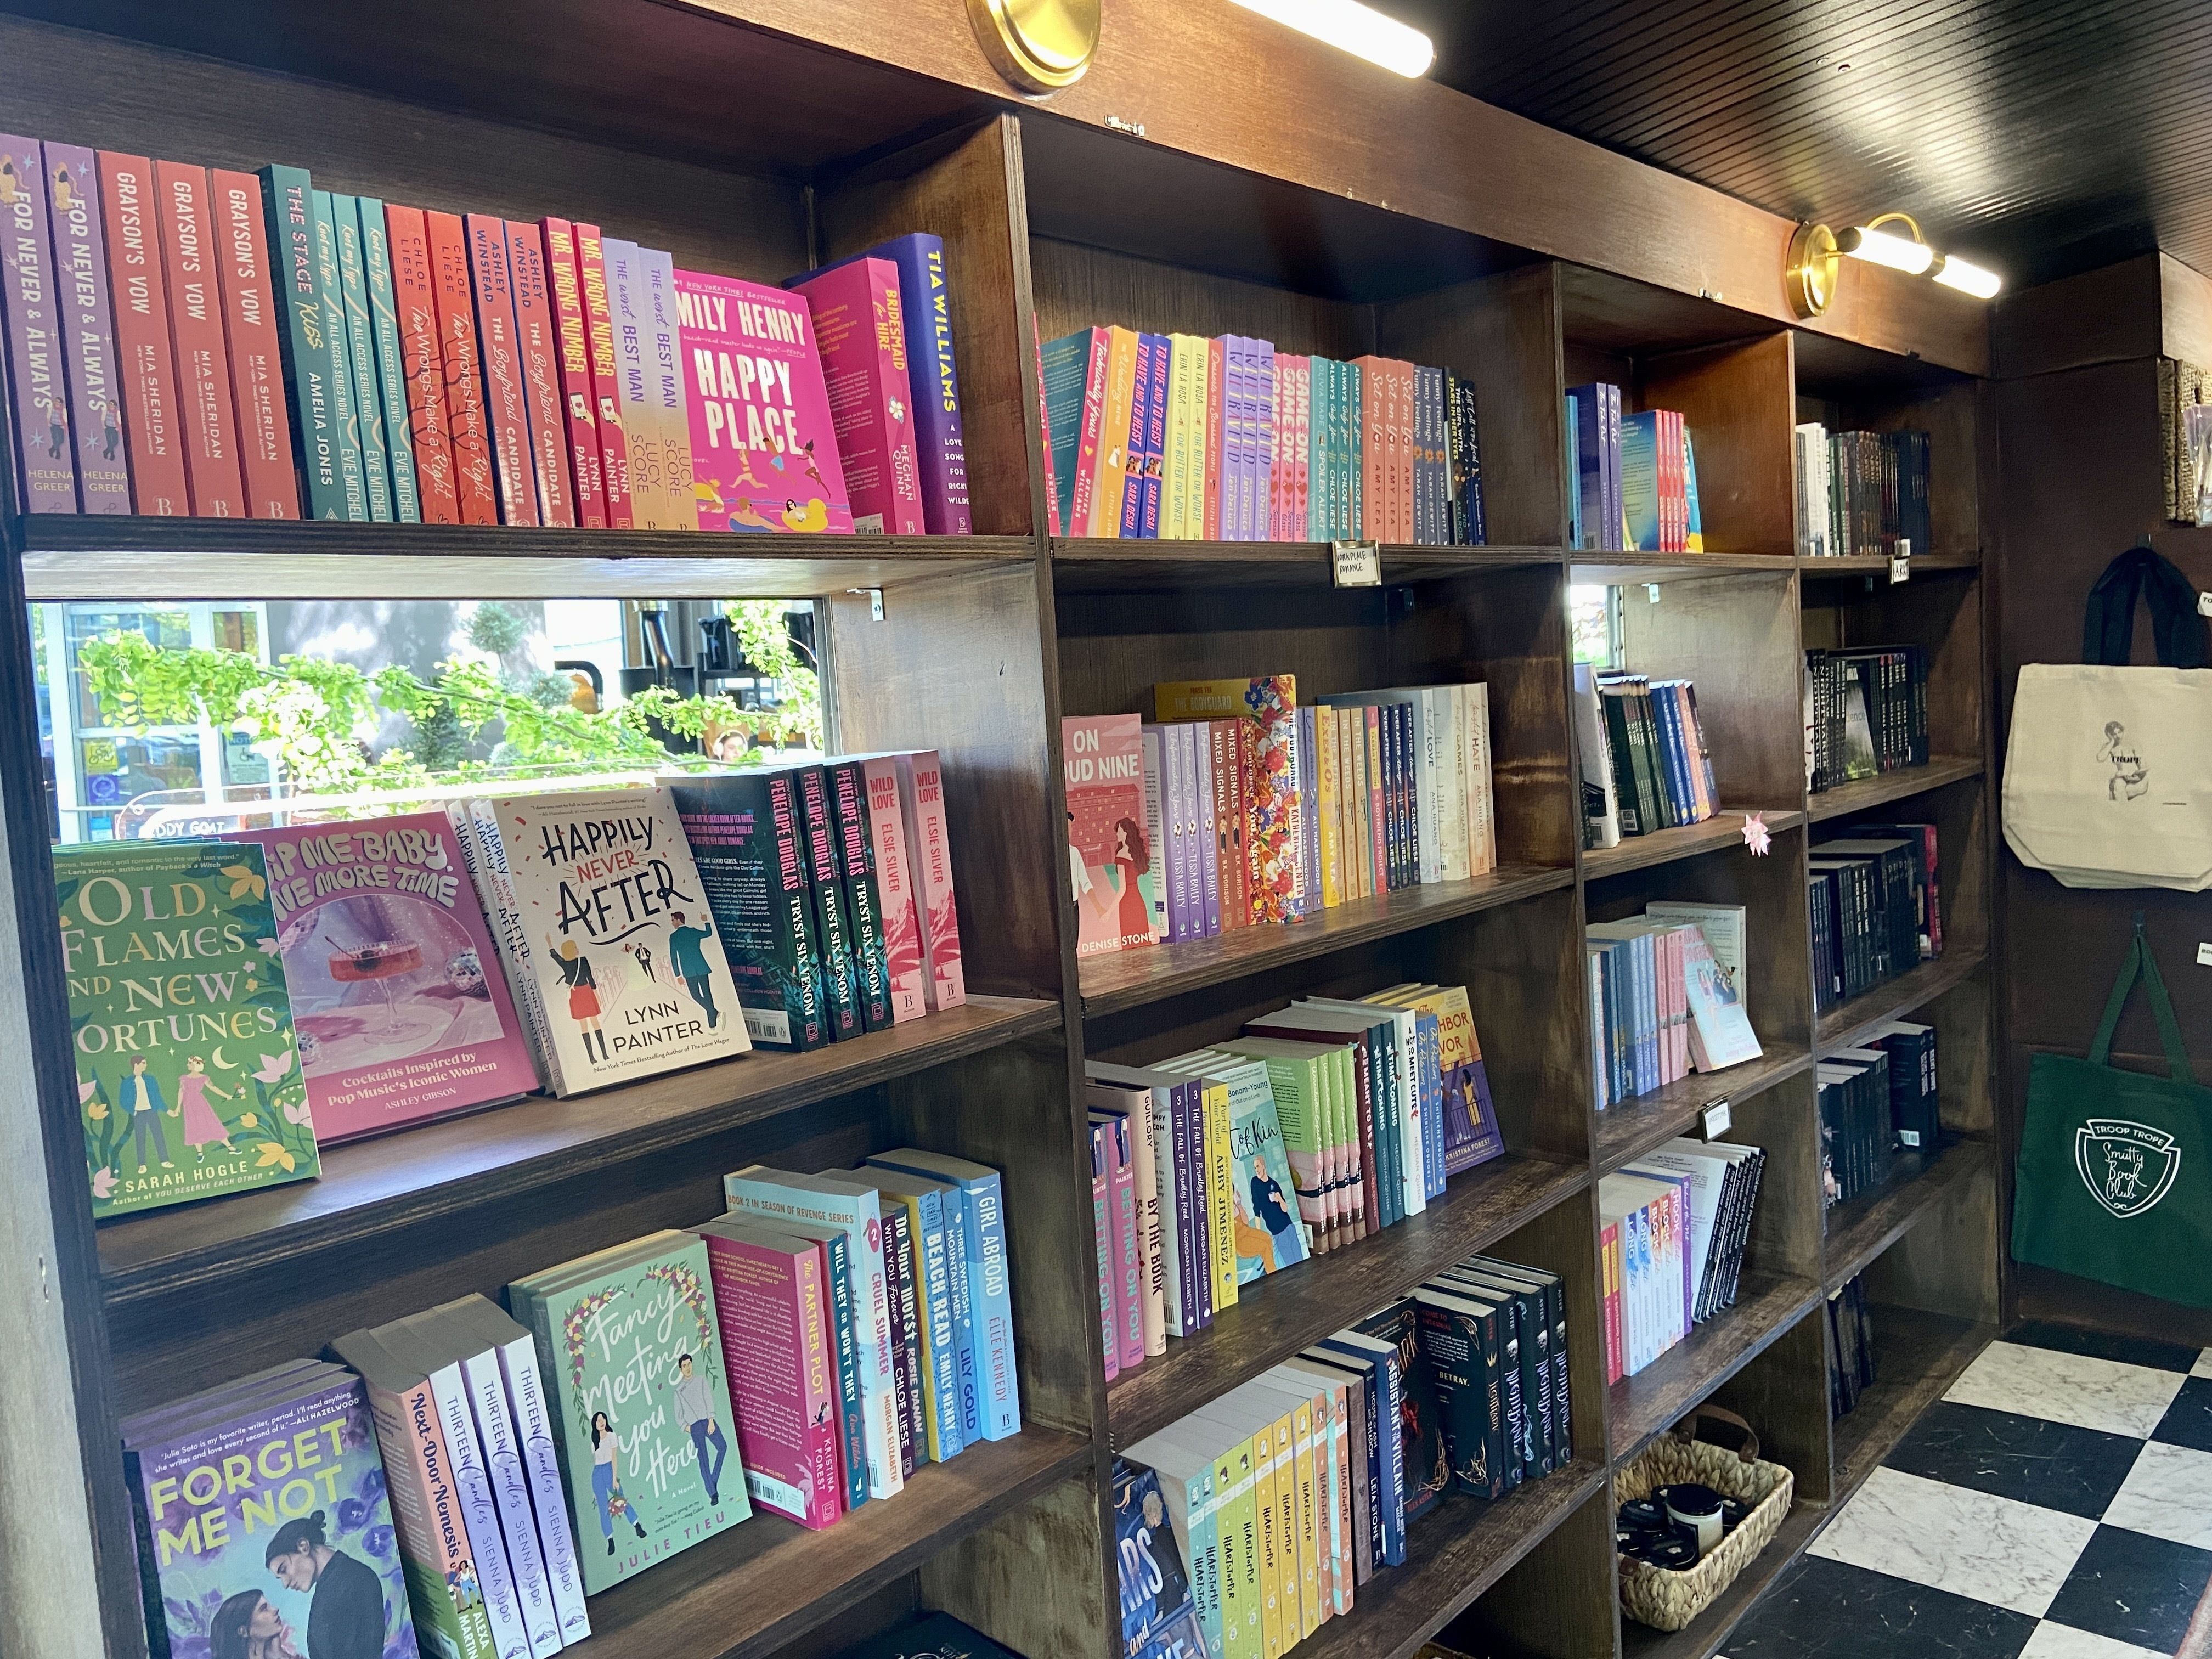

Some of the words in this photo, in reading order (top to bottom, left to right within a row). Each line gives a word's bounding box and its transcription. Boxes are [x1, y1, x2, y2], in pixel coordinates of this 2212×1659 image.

[12, 190, 34, 231] FOR
[287, 185, 305, 225] THE
[229, 189, 256, 278] GRAYSON'S
[549, 231, 573, 256] MR.
[16, 235, 41, 302] NEVER
[292, 231, 312, 294] STAGE
[616, 259, 628, 280] THE
[928, 251, 943, 289] TIA
[552, 263, 580, 311] WRONG
[619, 285, 636, 319] worst
[724, 287, 743, 296] TIMES
[747, 292, 786, 305] BESTSELLER
[27, 308, 37, 319] &
[240, 289, 261, 325] VOW
[295, 301, 323, 350] Kiss
[675, 290, 727, 332] MILY
[737, 301, 805, 346] HENRY
[560, 316, 587, 373] NUMBER
[623, 325, 641, 364] BEST
[877, 321, 890, 351] HIRE
[885, 289, 905, 371] BRIDESMAID
[26, 325, 52, 410] ALWAYS
[256, 356, 267, 380] MIA
[933, 294, 956, 412] WILLIAMS
[1156, 345, 1167, 359] TO
[628, 369, 644, 402] MAN
[693, 348, 793, 407] HAPPY
[1154, 360, 1166, 388] HAVE
[309, 372, 326, 430] AMELIA
[1152, 407, 1163, 418] TO
[1153, 390, 1164, 405] AND
[259, 386, 278, 460] SHERIDAN
[704, 400, 804, 455] PLACE
[1150, 420, 1163, 449] HEIST
[317, 435, 332, 486] JONES
[944, 438, 962, 447] LOVE
[945, 453, 964, 461] SONG
[28, 469, 74, 481] HELENA
[631, 435, 649, 493] SCORE
[646, 443, 661, 488] LUCY
[33, 482, 71, 492] GREER
[948, 482, 967, 490] RICKI
[1147, 484, 1157, 504] SARA
[1146, 506, 1156, 531] DESAI
[1340, 562, 1364, 574] ROMANCE
[1073, 729, 1098, 753] ON
[1214, 732, 1223, 764] MIXED
[870, 777, 894, 793] WILD
[1098, 754, 1139, 778] NINE
[770, 778, 785, 836] PENELOPE
[873, 794, 895, 810] LOVE
[1216, 766, 1226, 813] SIGNALS
[542, 816, 653, 866] HAPPILY
[882, 823, 896, 855] ELSIE
[576, 849, 639, 884] NEVER
[777, 836, 798, 891] DOUGLAS
[885, 858, 900, 893] SILVER
[78, 876, 206, 926] OLD
[272, 882, 315, 923] NE
[316, 865, 390, 898] MORE
[558, 859, 694, 937] AFTER
[791, 896, 804, 937] TRYST
[62, 924, 245, 972] FLAMES
[796, 939, 808, 964] SIX
[1081, 938, 1119, 952] DENISE
[1121, 932, 1155, 945] STONE
[69, 976, 110, 998] ND
[119, 970, 239, 1013] NEW
[799, 966, 814, 1016] VENOM
[77, 1006, 277, 1054] ORTUNES
[625, 1000, 679, 1025] LYNN
[613, 1020, 703, 1053] PAINTER
[1406, 1036, 1415, 1046] NOT
[342, 1066, 403, 1088] Cocktails
[405, 1054, 459, 1075] Inspired
[464, 1051, 478, 1064] by
[637, 1053, 665, 1063] Bestselling
[328, 1092, 354, 1107] Pop
[357, 1082, 408, 1102] Music's
[409, 1071, 445, 1090] Iconic
[449, 1060, 498, 1082] Women
[385, 1096, 420, 1110] ASHLEY
[422, 1087, 456, 1103] GIBSON
[1228, 1081, 1268, 1098] Bonam-Young
[2103, 1142, 2143, 1168] Smutty
[2134, 1129, 2165, 1146] TROPE
[126, 1172, 184, 1193] SARAH
[193, 1161, 248, 1181] HOGLE
[1216, 1155, 1225, 1191] ABBY
[2106, 1180, 2137, 1199] Club
[2107, 1160, 2147, 1187] Book
[728, 1195, 743, 1205] BOOK
[761, 1201, 785, 1214] SEASON
[787, 1206, 794, 1215] OF
[797, 1207, 826, 1221] REVENGE
[828, 1212, 854, 1224] SERIES
[978, 1197, 998, 1233] GIRL
[1147, 1197, 1159, 1218] BY
[1149, 1221, 1160, 1249] THE
[1217, 1196, 1229, 1265] JIMENEZ
[1651, 1205, 1660, 1249] BLOCK
[925, 1233, 945, 1294] BEACH
[982, 1235, 1003, 1298] ABROAD
[1150, 1250, 1164, 1295] BOOK
[585, 1284, 695, 1363] Fancy
[932, 1297, 951, 1348] READ
[582, 1334, 703, 1424] Meeting
[938, 1352, 952, 1393] EMILY
[960, 1348, 973, 1377] LILY
[1439, 1370, 1470, 1387] BETRAY.
[520, 1365, 542, 1435] THIRTEEN
[940, 1394, 955, 1432] HENRY
[962, 1383, 977, 1431] GOLD
[1388, 1362, 1400, 1430] ASSISTANT
[619, 1404, 667, 1477] you
[149, 1417, 347, 1521] FORGET
[410, 1393, 441, 1483] Next-Door
[433, 1483, 459, 1558] Nemesis
[645, 1435, 698, 1499] Here
[1392, 1441, 1402, 1496] VILLAIN
[157, 1506, 231, 1567] ME
[240, 1464, 342, 1534] NOT
[548, 1505, 565, 1557] SIENNA
[558, 1555, 573, 1592] JUDD
[618, 1539, 672, 1575] JULIE
[684, 1511, 726, 1541] TIEU
